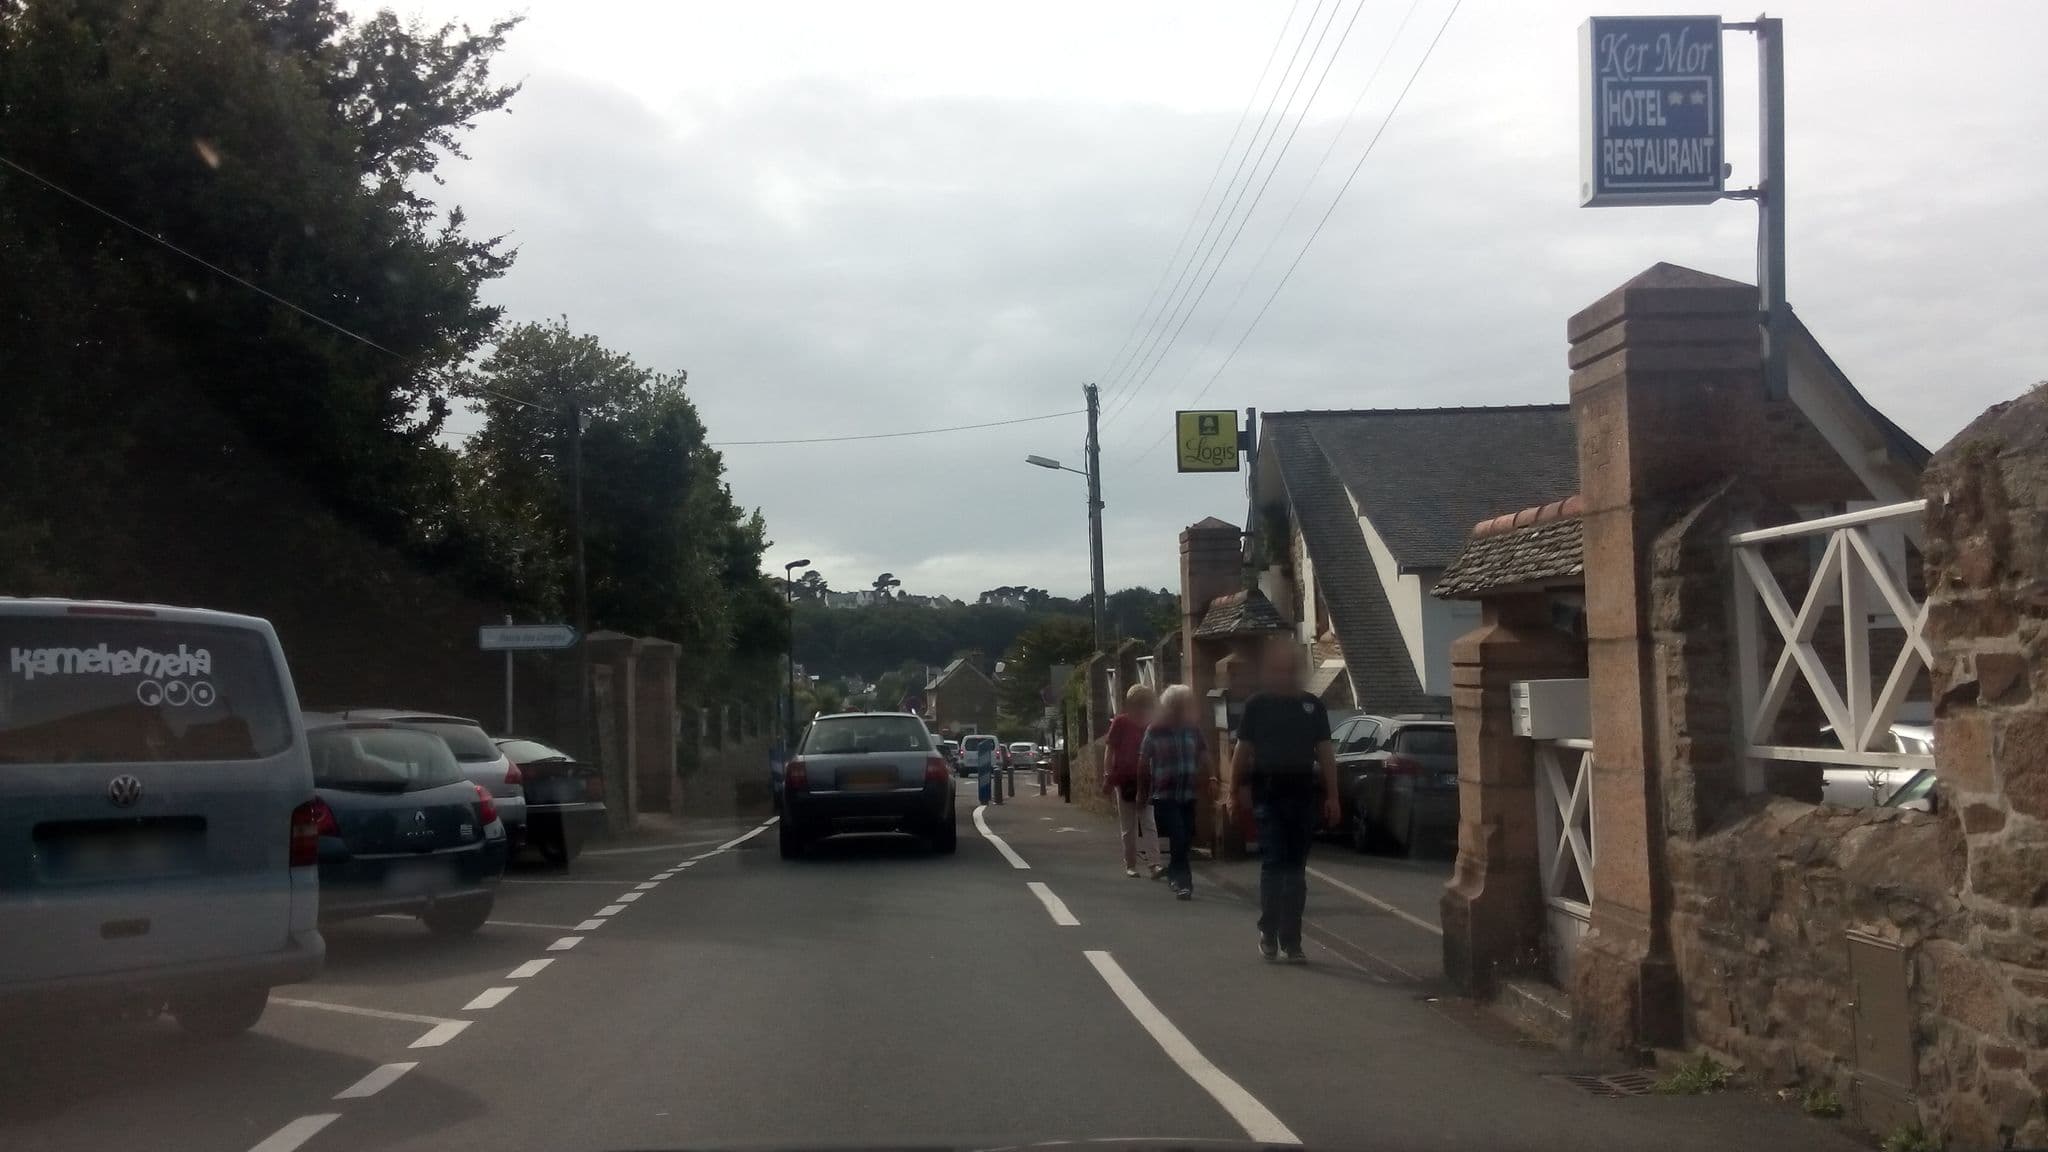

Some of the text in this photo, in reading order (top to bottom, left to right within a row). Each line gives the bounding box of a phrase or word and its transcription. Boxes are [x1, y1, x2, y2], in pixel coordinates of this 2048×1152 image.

[1600, 27, 1713, 82] Ker Mor
[1608, 89, 1667, 126] HOTEL
[1603, 138, 1715, 175] RESTAURANT
[1184, 437, 1235, 466] Logis
